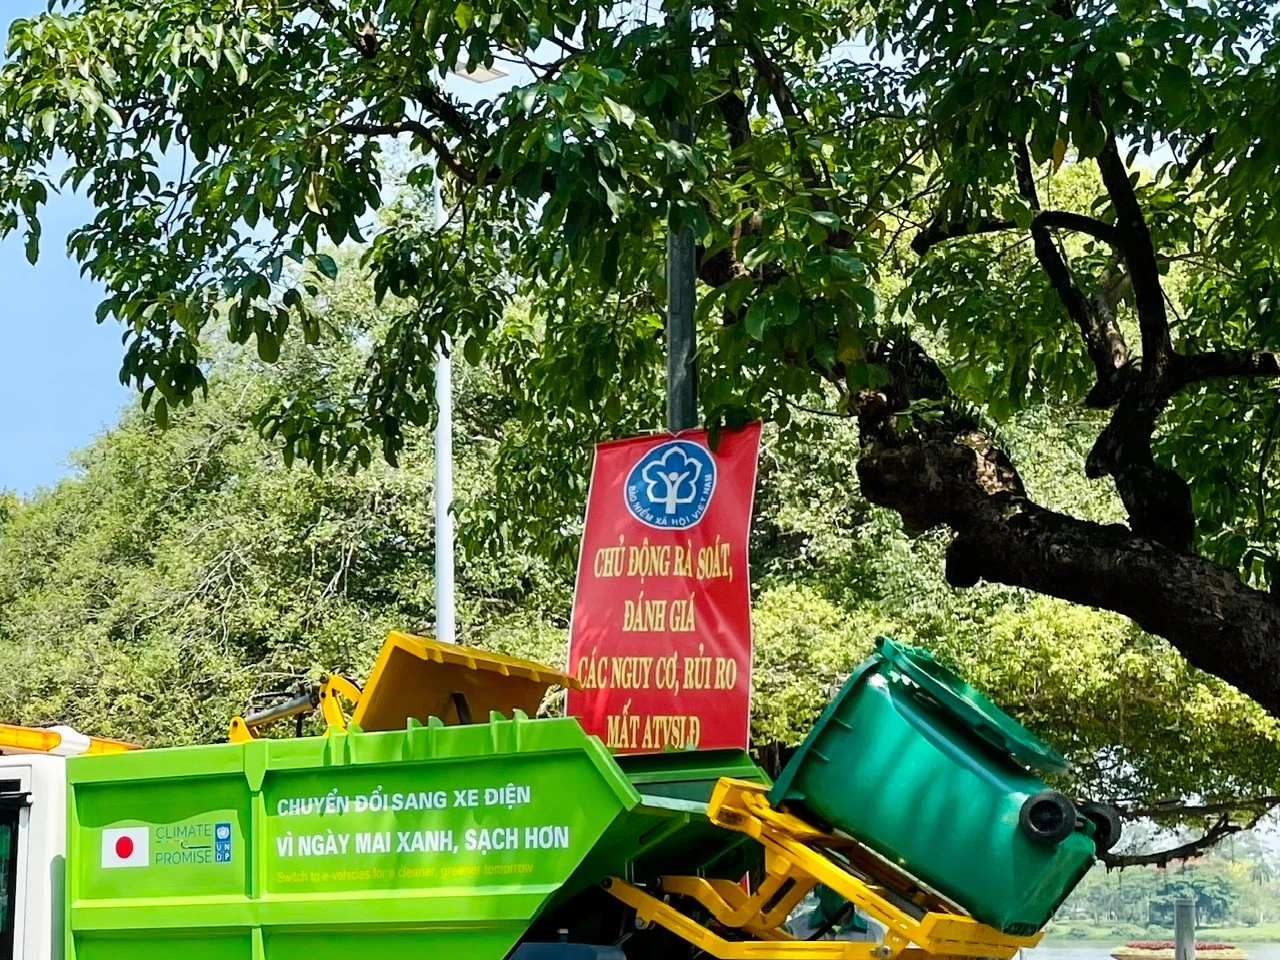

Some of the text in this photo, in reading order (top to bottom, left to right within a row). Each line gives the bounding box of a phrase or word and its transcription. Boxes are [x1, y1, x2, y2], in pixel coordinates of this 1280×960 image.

[703, 473, 713, 495] NAM
[594, 534, 733, 584] CHỦ ĐỘNG RÀ SOÁT,
[622, 590, 696, 632] ĐÁNH GIÁ
[577, 642, 738, 696] CÁC NGUY CƠ, RỦI RO
[606, 698, 641, 749] MẤT
[277, 782, 531, 817] CHUYỂN ĐỔI SANG XE ĐIỆN
[156, 823, 212, 840] CLIMATE
[276, 825, 569, 857] VÌ NGÀY MAI XANH, SẠCH HƠN
[155, 850, 212, 865] PROMISE
[277, 871, 308, 883] Switch
[311, 870, 319, 881] to
[320, 868, 371, 881] e-vehicles
[373, 867, 386, 878] for
[388, 869, 395, 878] a
[440, 865, 481, 880] greener
[483, 864, 534, 875] tomorrow
